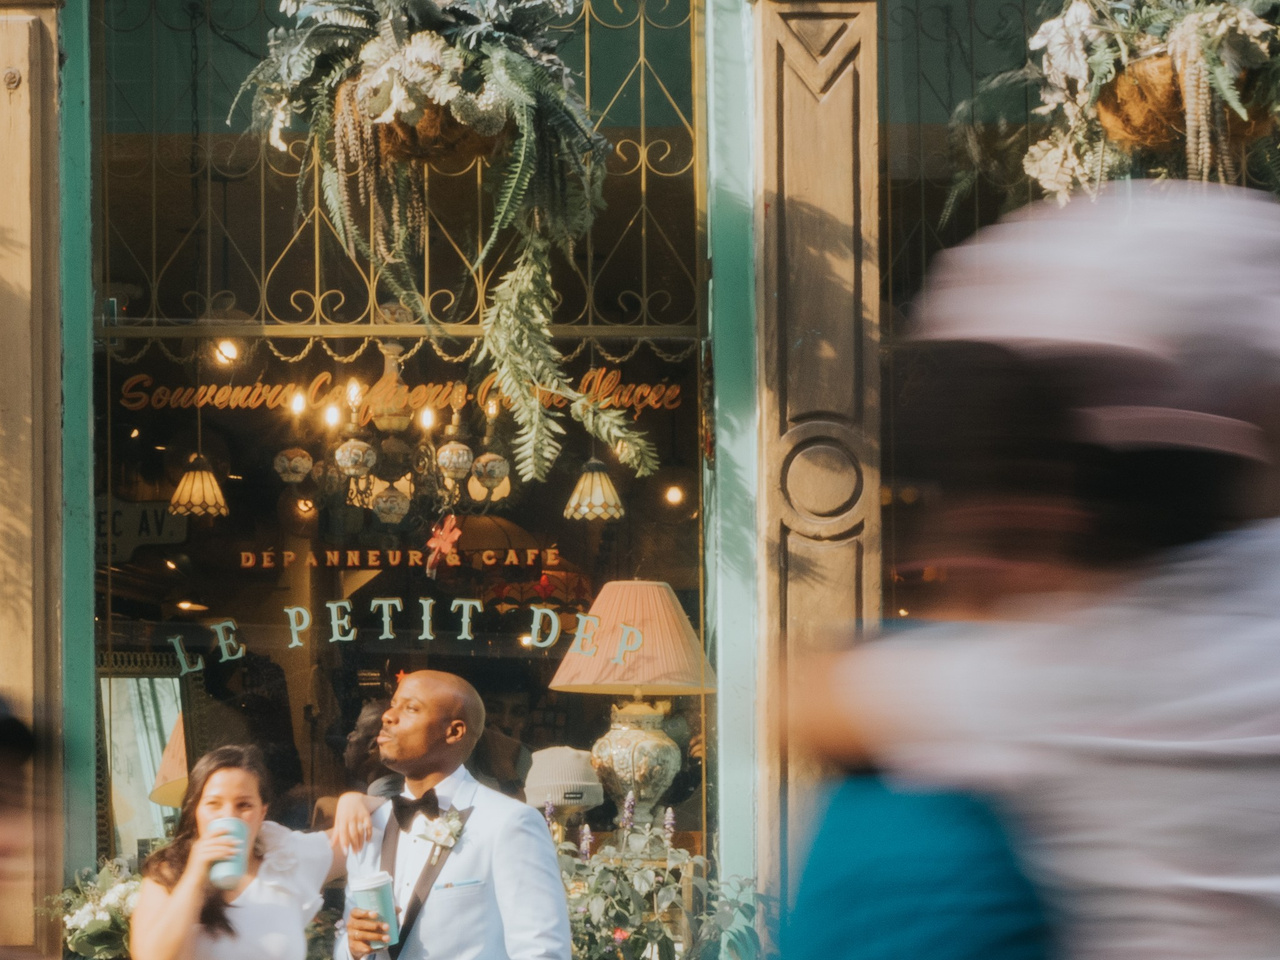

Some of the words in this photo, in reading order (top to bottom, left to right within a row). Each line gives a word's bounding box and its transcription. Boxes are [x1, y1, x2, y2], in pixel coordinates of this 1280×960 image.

[240, 546, 423, 568] DÉPANNEUR
[482, 543, 561, 567] CAFÉ
[167, 617, 247, 677] LE
[283, 597, 485, 649] PETIT
[530, 605, 644, 666] DEP
